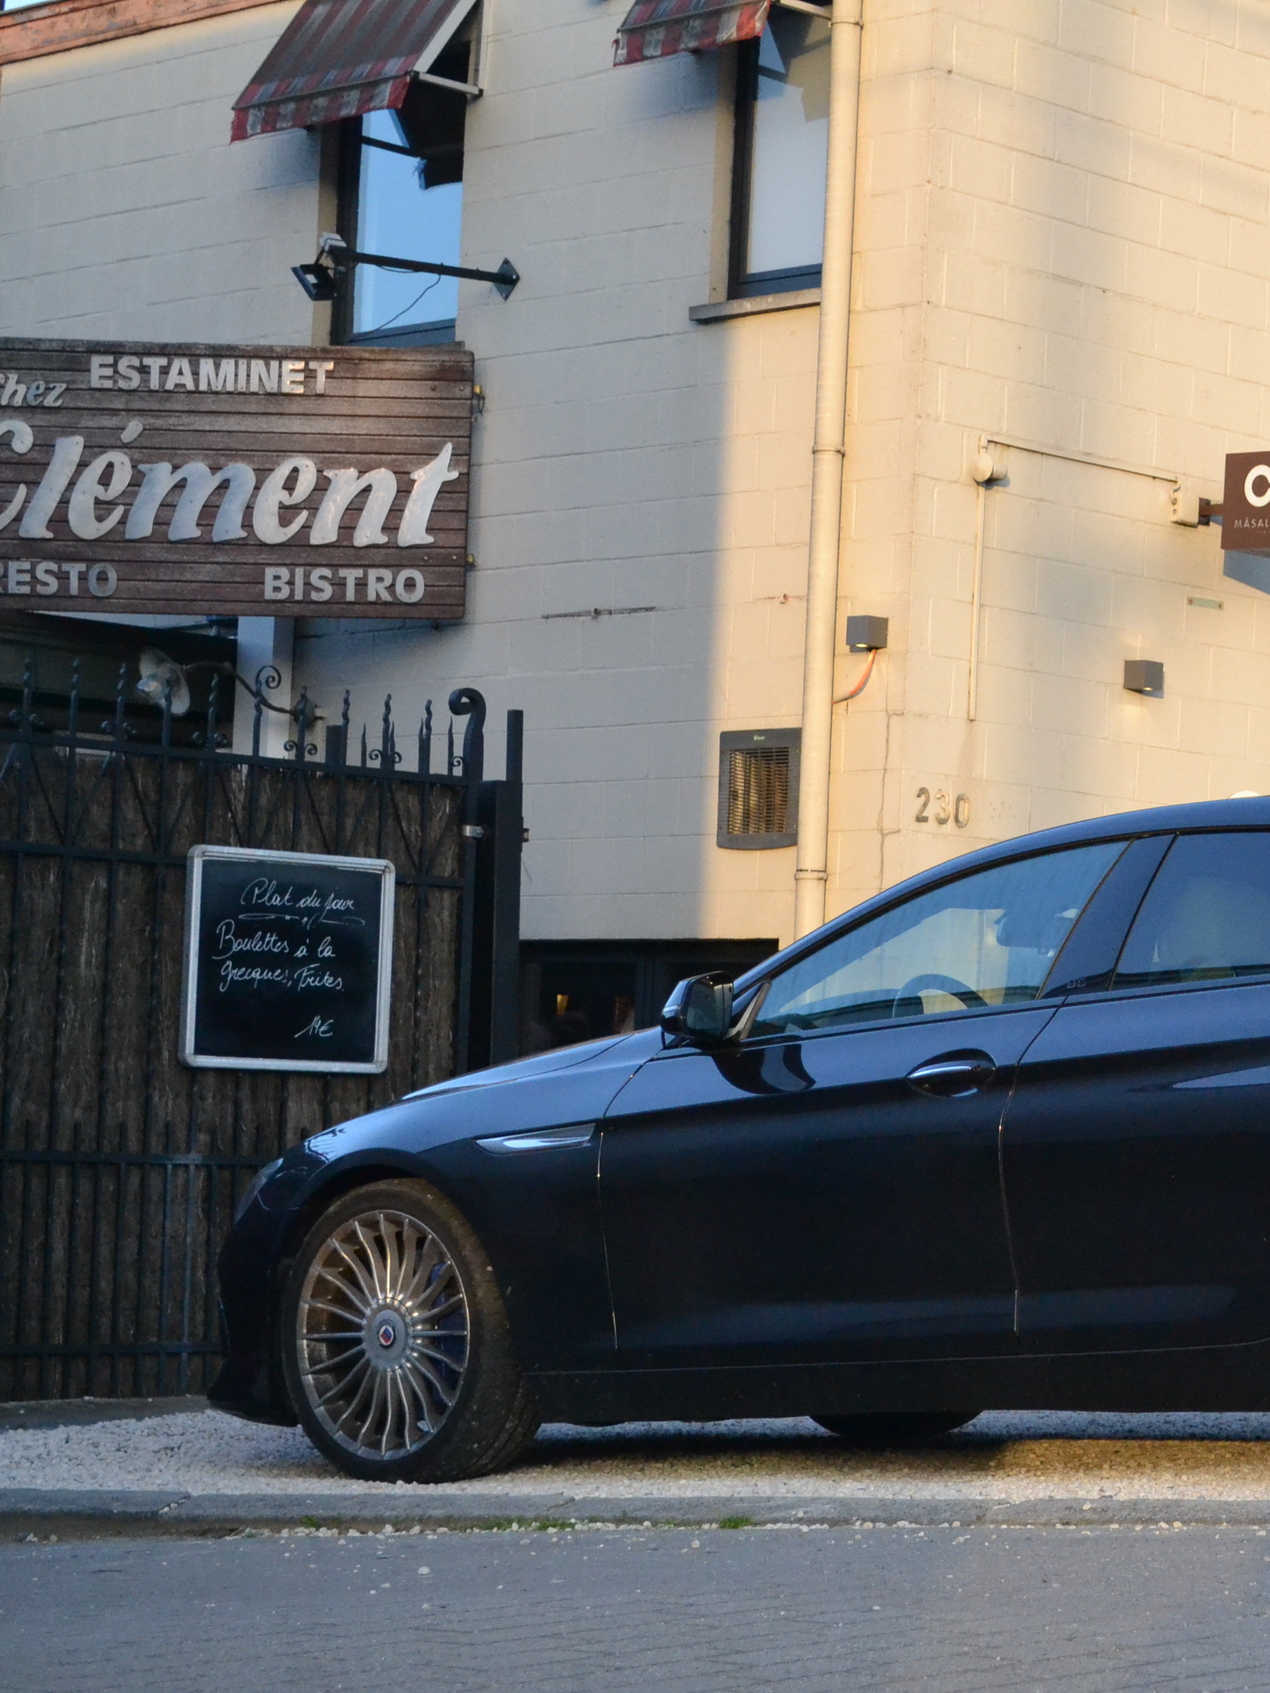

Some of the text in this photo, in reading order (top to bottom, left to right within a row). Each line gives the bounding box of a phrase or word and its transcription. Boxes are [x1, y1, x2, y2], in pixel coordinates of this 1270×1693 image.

[0, 374, 67, 407] hez
[90, 355, 335, 395] ESTAMINET
[0, 560, 425, 604] ESTO BISTRO
[914, 786, 970, 829] 230
[240, 877, 355, 929] Plat du jour
[211, 918, 290, 960] Boulettes
[317, 935, 337, 958] la
